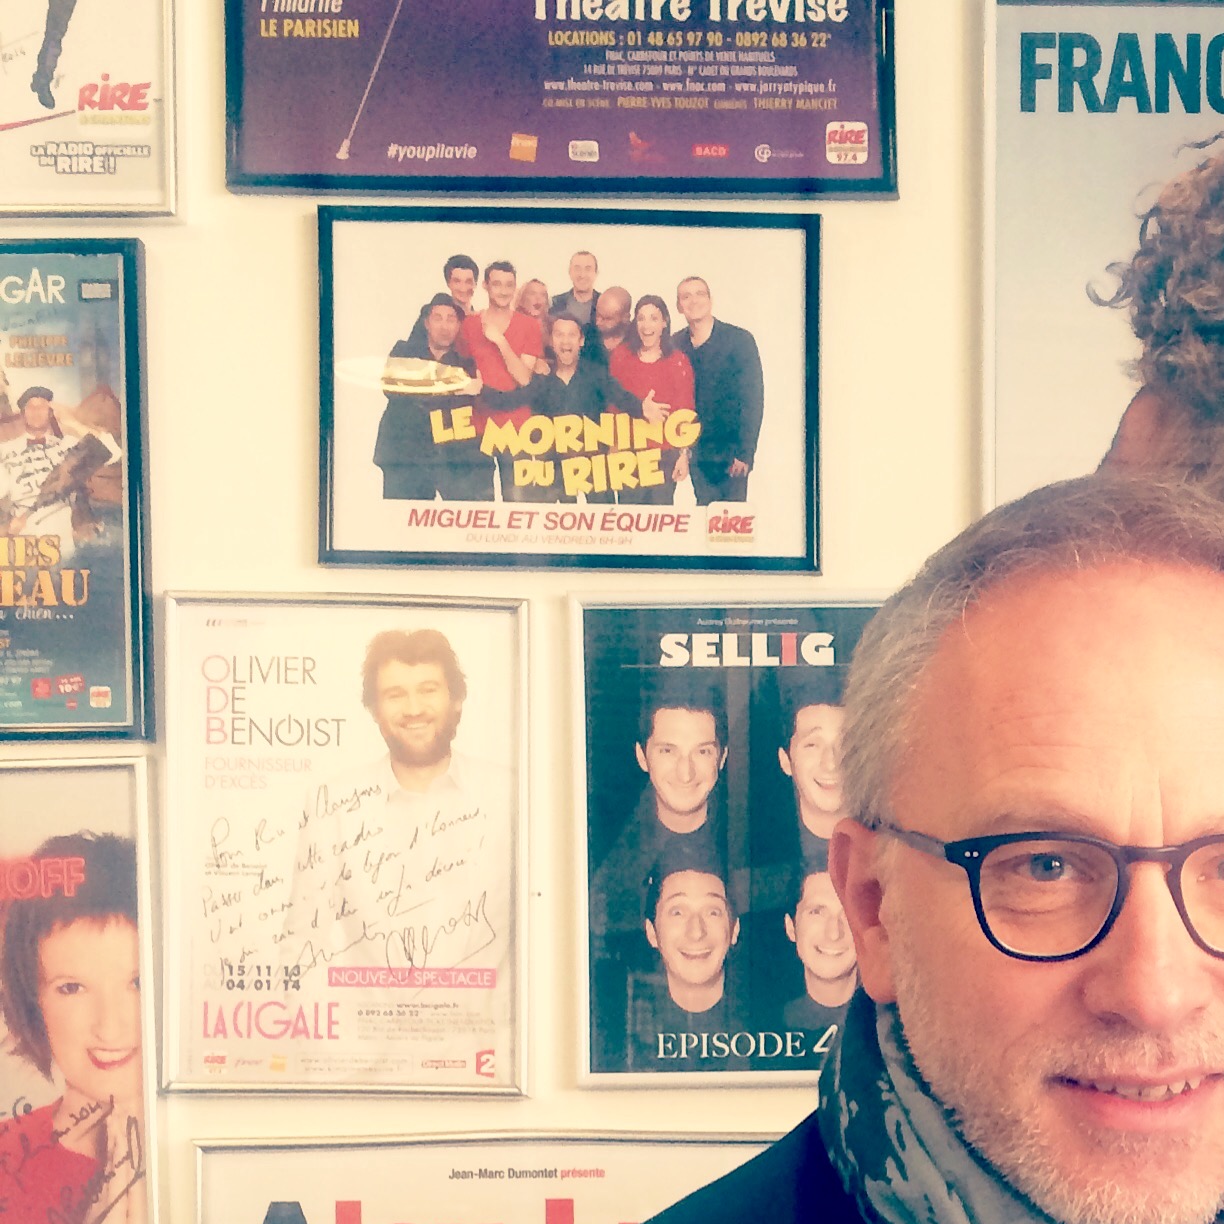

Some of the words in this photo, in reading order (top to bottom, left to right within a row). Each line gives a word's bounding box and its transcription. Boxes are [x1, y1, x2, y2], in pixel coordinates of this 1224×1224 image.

[260, 19, 277, 37] LE
[283, 19, 359, 38] PARISIEN
[548, 31, 616, 47] LOCATIONS
[627, 32, 642, 47] 01
[647, 32, 664, 47] 48
[666, 32, 682, 47] 65
[686, 32, 702, 48] 97
[706, 32, 723, 48] 90
[735, 32, 768, 48] 0892
[77, 72, 152, 112] RIRE
[45, 141, 95, 156] RADIO
[387, 142, 478, 161] #youpilavie
[56, 157, 104, 173] RIRE
[429, 404, 477, 445] LE
[479, 407, 702, 458] MORNING
[512, 458, 555, 488] DU
[560, 448, 666, 497] RIRE
[407, 508, 501, 530] MIGUEL
[506, 509, 542, 531] ET
[543, 510, 596, 532] SON
[600, 506, 691, 534] ÉQUIPE
[708, 507, 756, 535] RIRE
[659, 631, 836, 667] SELLIG
[201, 654, 318, 685] OLIVIER
[205, 685, 247, 715] DE
[205, 713, 347, 747] BENOIST
[204, 757, 313, 772] FOURNISSEUR
[331, 969, 409, 986] NOUVEAU
[414, 970, 492, 987] SPECTACLE
[656, 1030, 806, 1059] EPISODE
[448, 1167, 505, 1180] Jean-Marc
[507, 1167, 558, 1179] Dumontet
[560, 1166, 606, 1180] présente
